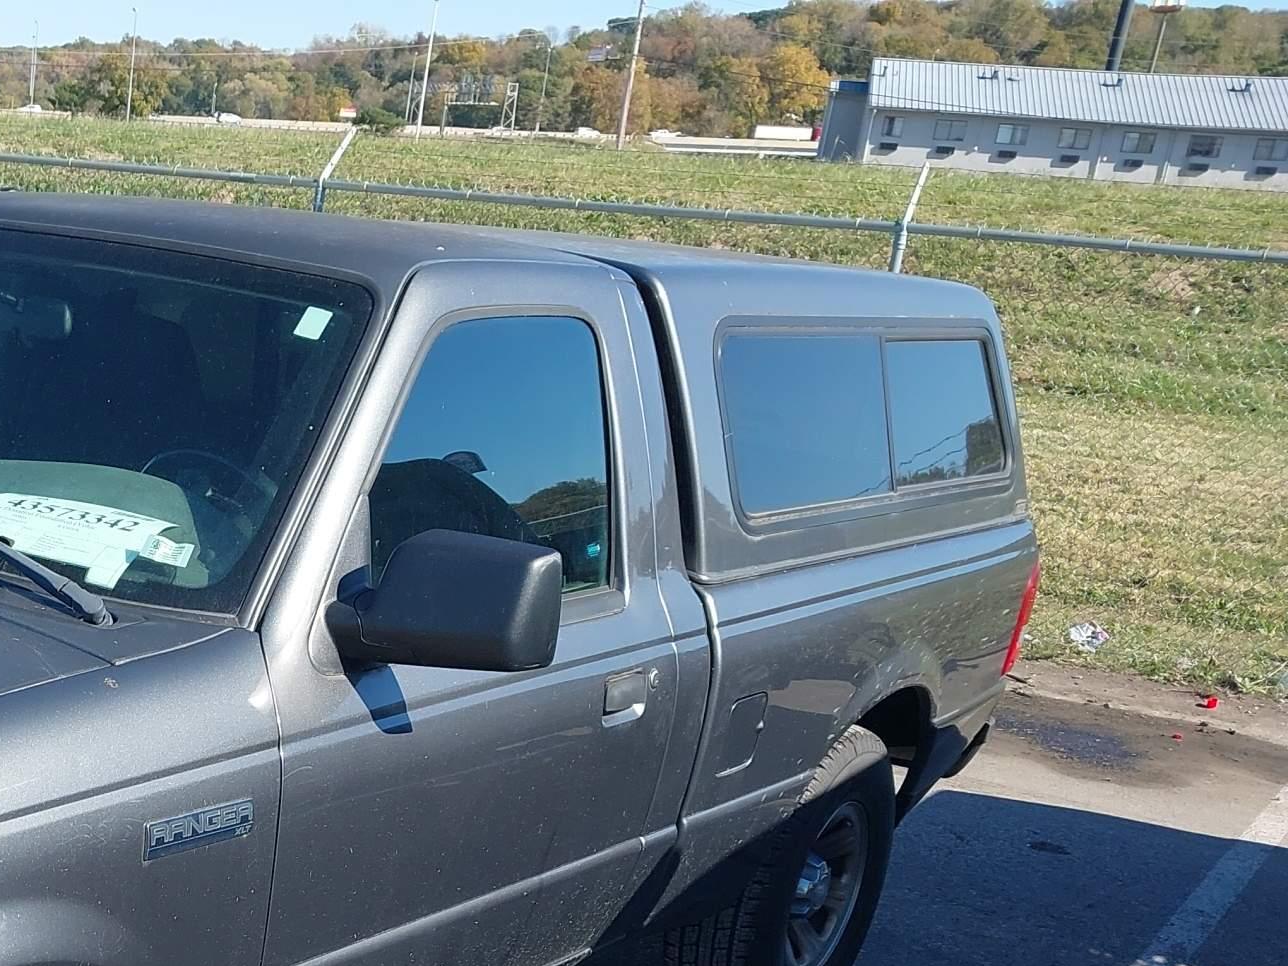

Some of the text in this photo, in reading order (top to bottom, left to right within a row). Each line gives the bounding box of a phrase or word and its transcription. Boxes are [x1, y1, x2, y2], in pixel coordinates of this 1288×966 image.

[8, 499, 140, 533] 43573342
[151, 802, 254, 846] RANGER
[234, 824, 253, 836] XLT
